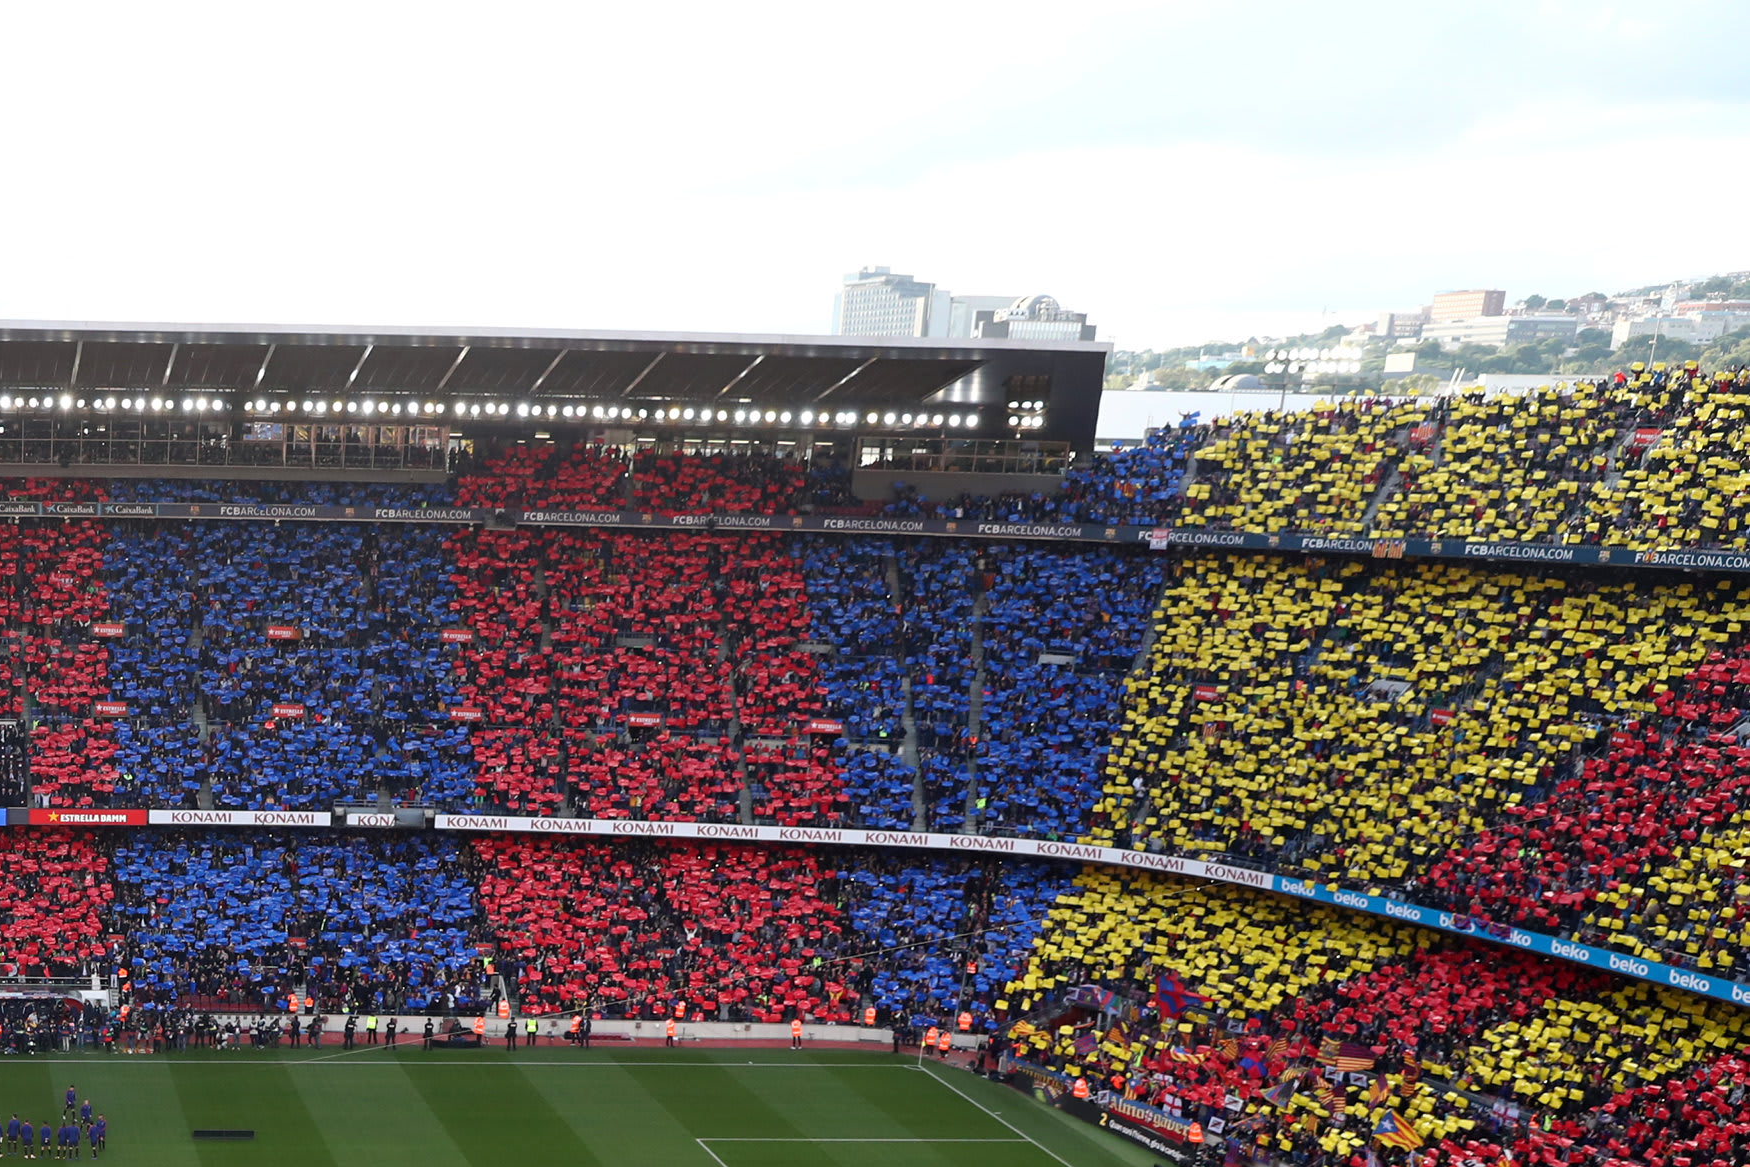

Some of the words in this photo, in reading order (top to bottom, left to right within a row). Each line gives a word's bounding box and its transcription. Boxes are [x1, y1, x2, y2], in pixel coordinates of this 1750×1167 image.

[57, 504, 95, 513] CaixaBank
[115, 505, 153, 514] CaixaBank
[375, 509, 471, 519] FCBARCELONA.COM
[524, 512, 620, 523] FCBARCELONA.COM
[824, 519, 923, 531] FCBARCELONA.COM
[978, 524, 1081, 537] FCBARCELONA.COM
[1138, 531, 1244, 544] FCRCELONA.COM
[1465, 543, 1573, 559] FCBARCELONA.COM
[60, 814, 100, 822] ESTRELLA
[101, 814, 127, 823] DAMM
[171, 812, 232, 823] KONAMI
[254, 812, 315, 824] KONAMI
[446, 816, 508, 828] KONAMI
[530, 819, 592, 831] KONAMI
[612, 822, 674, 834] KONAMI
[697, 826, 759, 839] KONAMI
[780, 829, 842, 841] KONAMI
[865, 832, 928, 845] KONAMI
[949, 836, 1014, 850] KONAMI
[1036, 842, 1102, 859] KONAMI
[1121, 852, 1184, 871] KONAMI
[1205, 865, 1264, 885] KONAMI
[1385, 902, 1421, 921] beko
[1551, 939, 1589, 962] beko
[1609, 953, 1648, 976] beko
[1669, 969, 1710, 992] beko
[1731, 985, 1750, 1003] be
[1099, 1112, 1108, 1126] 2
